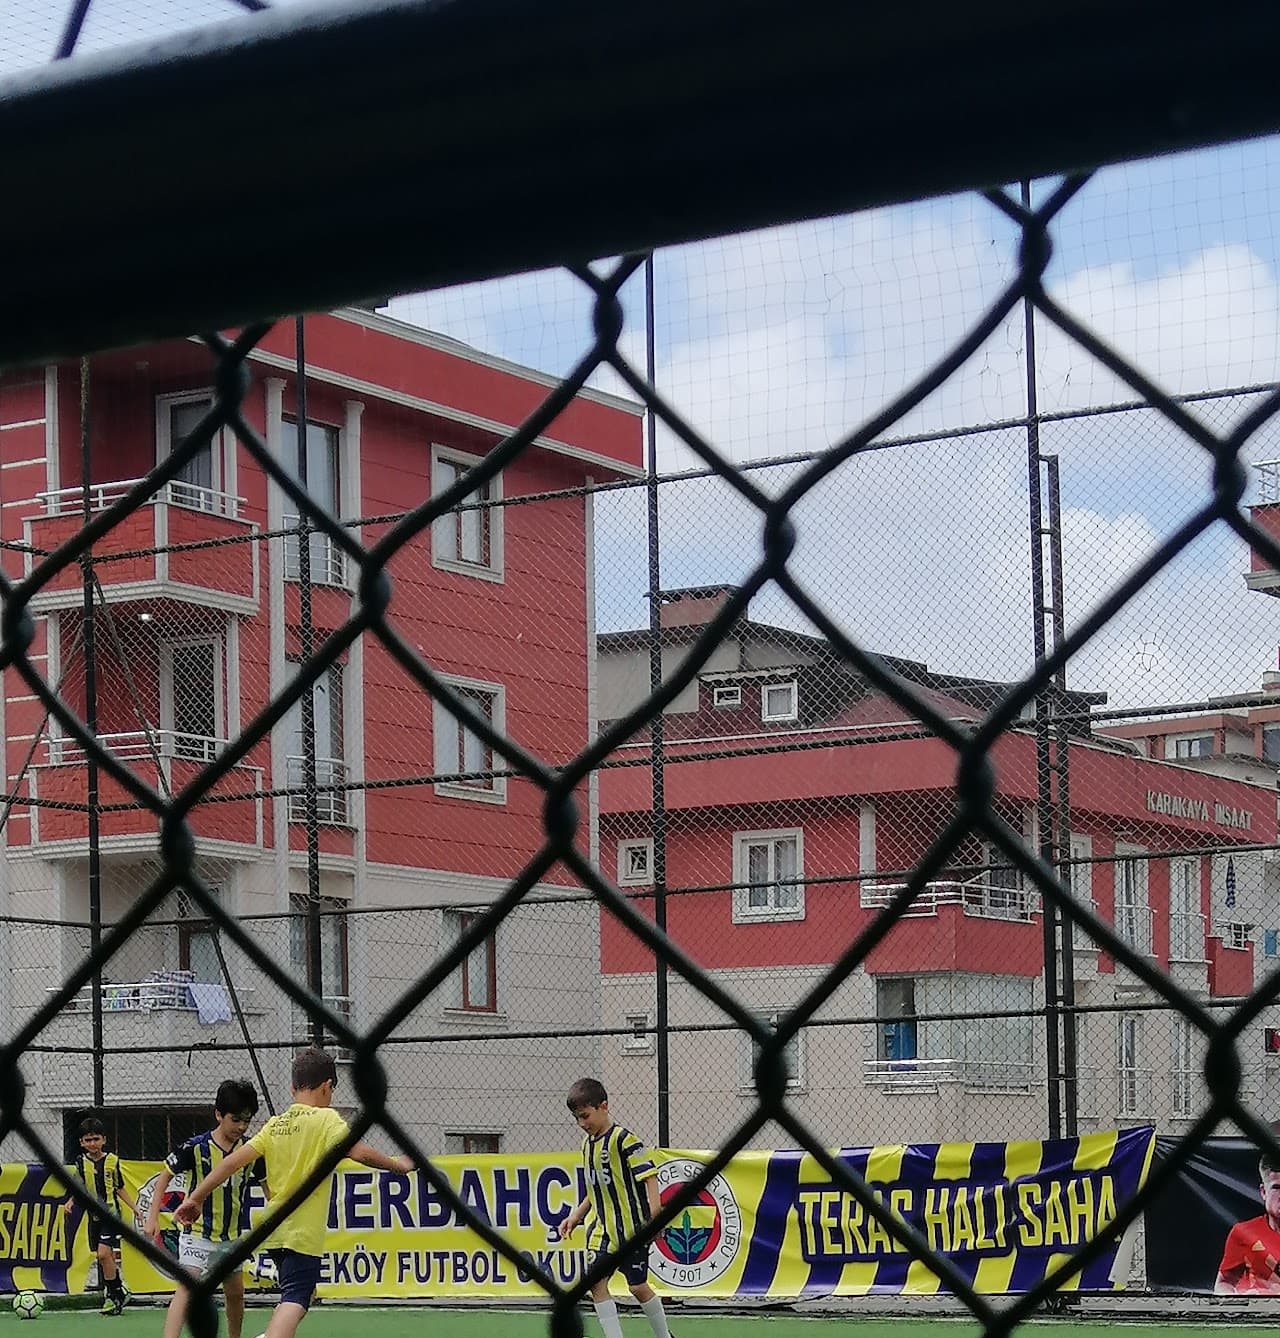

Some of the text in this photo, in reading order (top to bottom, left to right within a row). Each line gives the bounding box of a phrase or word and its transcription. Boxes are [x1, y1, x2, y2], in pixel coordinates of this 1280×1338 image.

[1146, 790, 1208, 821] KARAKAYA
[0, 1201, 67, 1261] SAHA
[718, 1193, 740, 1260] KULÜBÜ
[924, 1185, 1007, 1252] HALI
[1017, 1175, 1120, 1248] SAHA
[398, 1250, 506, 1284] FUTBOL
[671, 1267, 702, 1283] 1907
